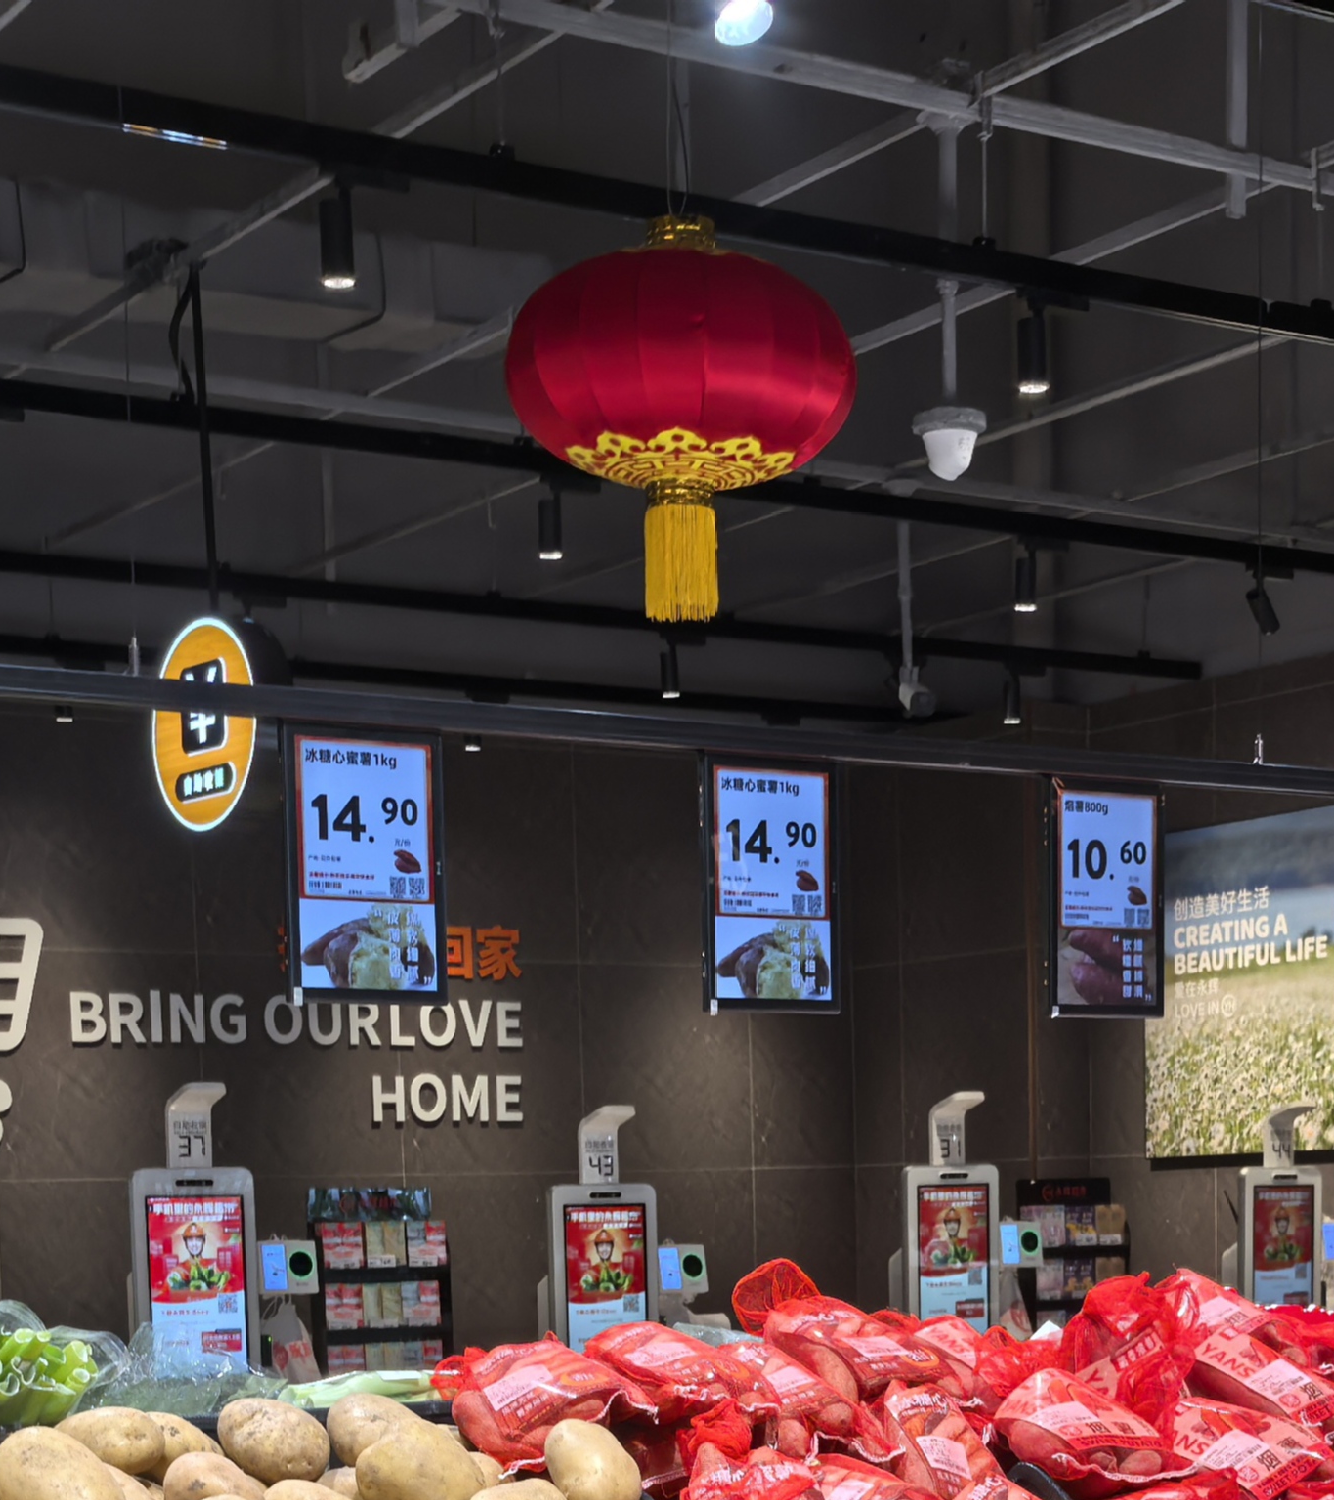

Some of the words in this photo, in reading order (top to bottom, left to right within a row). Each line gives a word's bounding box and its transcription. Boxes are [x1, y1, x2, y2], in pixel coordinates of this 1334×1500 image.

[1174, 886, 1270, 921] 创造美好生活
[1174, 914, 1270, 949] CREATING
[1273, 913, 1288, 935] A
[1174, 940, 1280, 976] BEAUTIFUL
[1285, 934, 1327, 962] LIFE
[68, 988, 248, 1045] BRING
[372, 1073, 525, 1124] HOME
[179, 1135, 206, 1158] 37
[589, 1155, 614, 1177] 43
